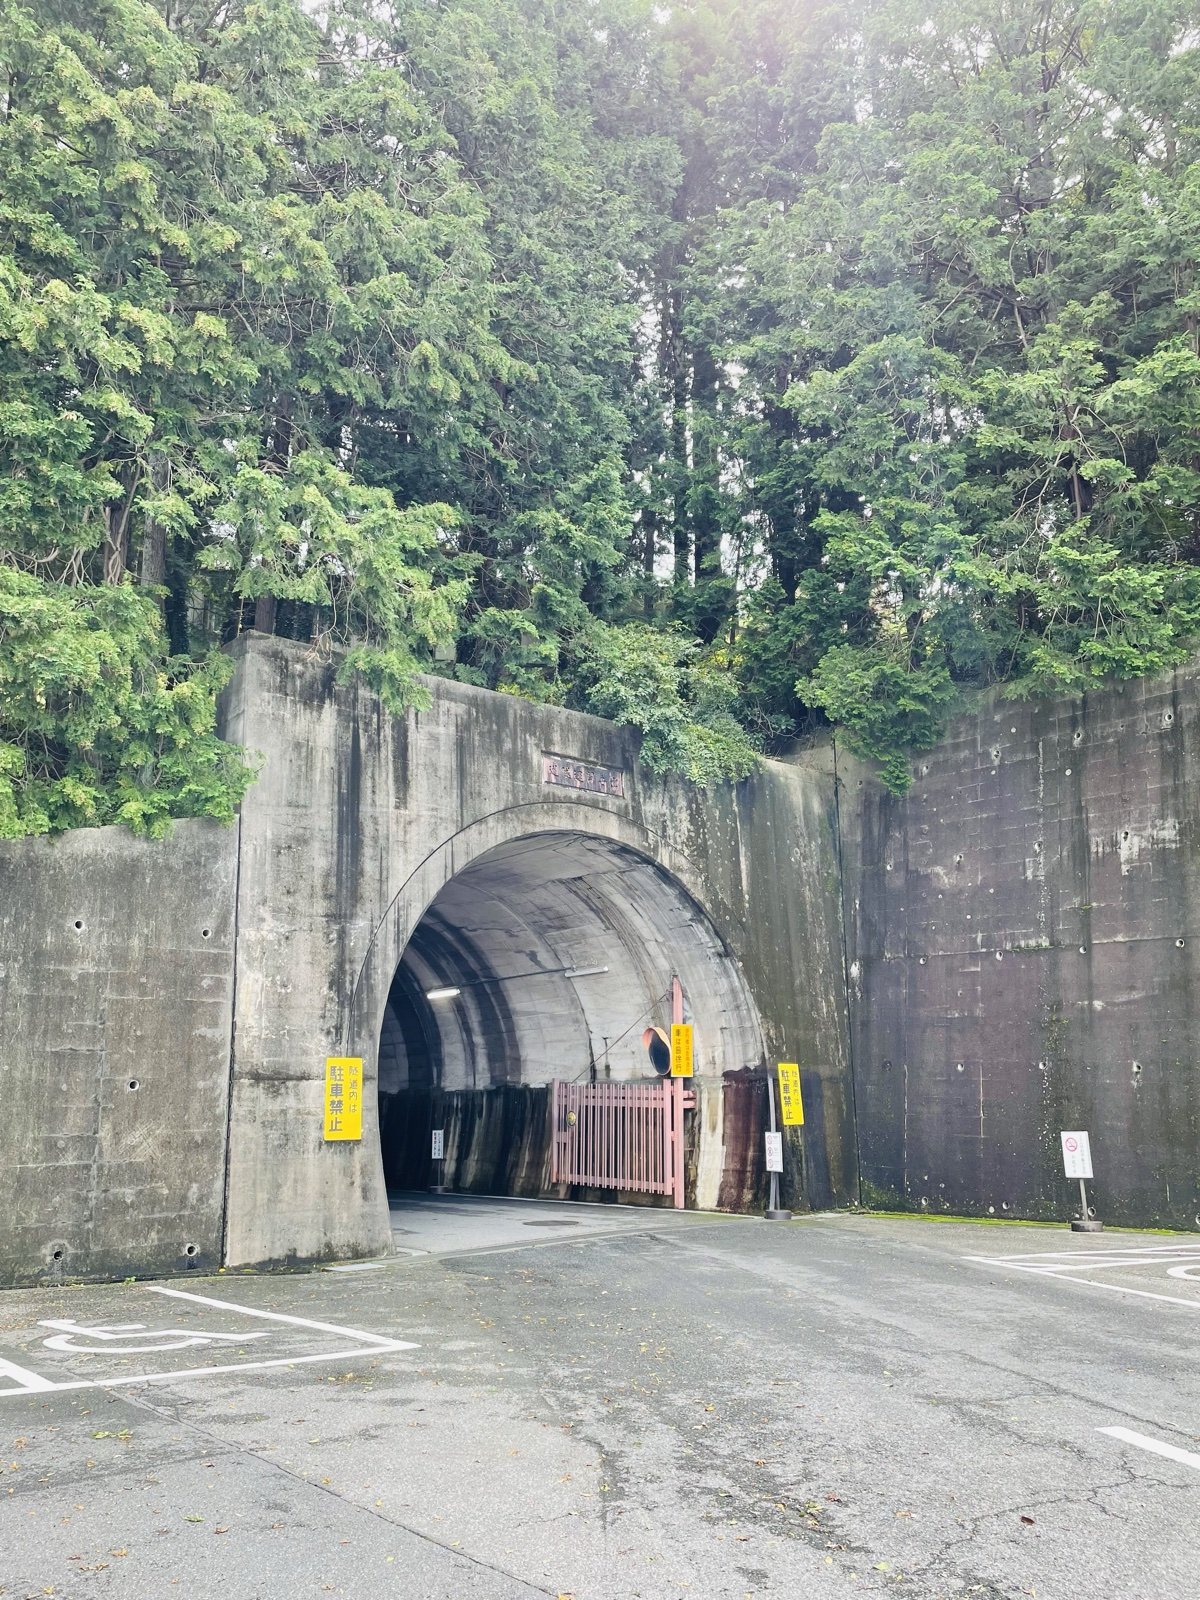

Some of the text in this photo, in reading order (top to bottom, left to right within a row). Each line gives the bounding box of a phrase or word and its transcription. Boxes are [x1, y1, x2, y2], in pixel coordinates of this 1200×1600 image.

[328, 1065, 345, 1132] 駐車禁止
[348, 1065, 358, 1113] 隧道内は
[780, 1069, 794, 1120] 駐車禁止
